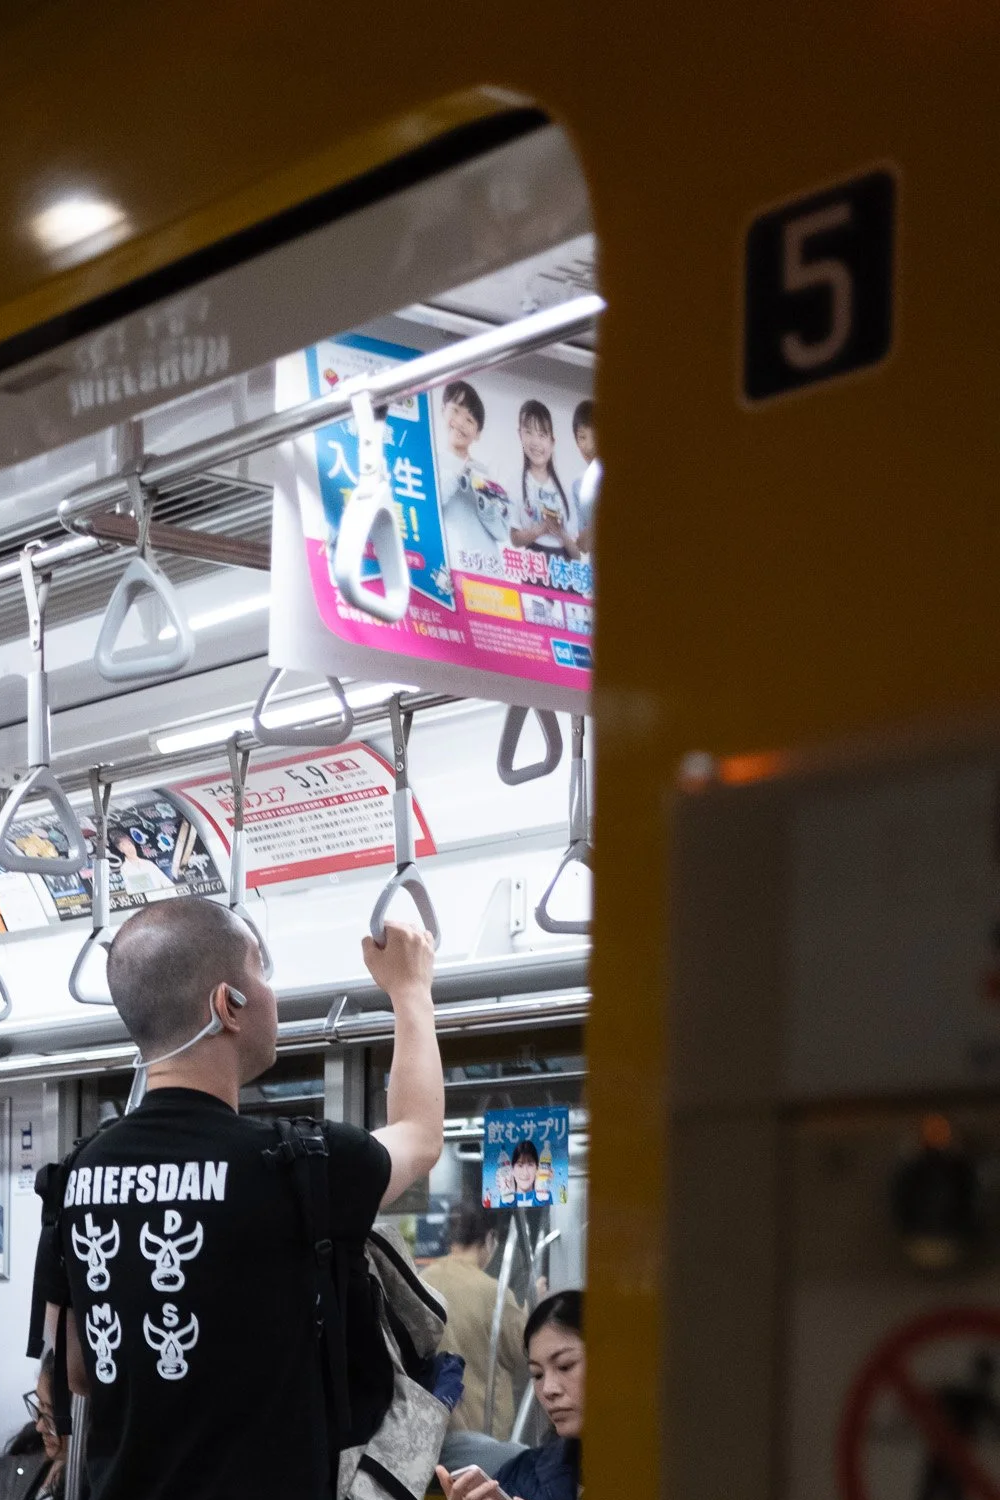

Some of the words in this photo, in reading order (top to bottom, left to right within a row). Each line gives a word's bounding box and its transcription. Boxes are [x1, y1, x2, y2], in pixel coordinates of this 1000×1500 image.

[781, 201, 853, 370] 5
[327, 440, 427, 500] 入生
[284, 765, 328, 788] 5.9
[487, 1117, 566, 1145] 飲むサプリ
[63, 1160, 229, 1207] BRIEFSDAN
[84, 1212, 102, 1238] L
[163, 1209, 182, 1234] D
[162, 1302, 179, 1328] S
